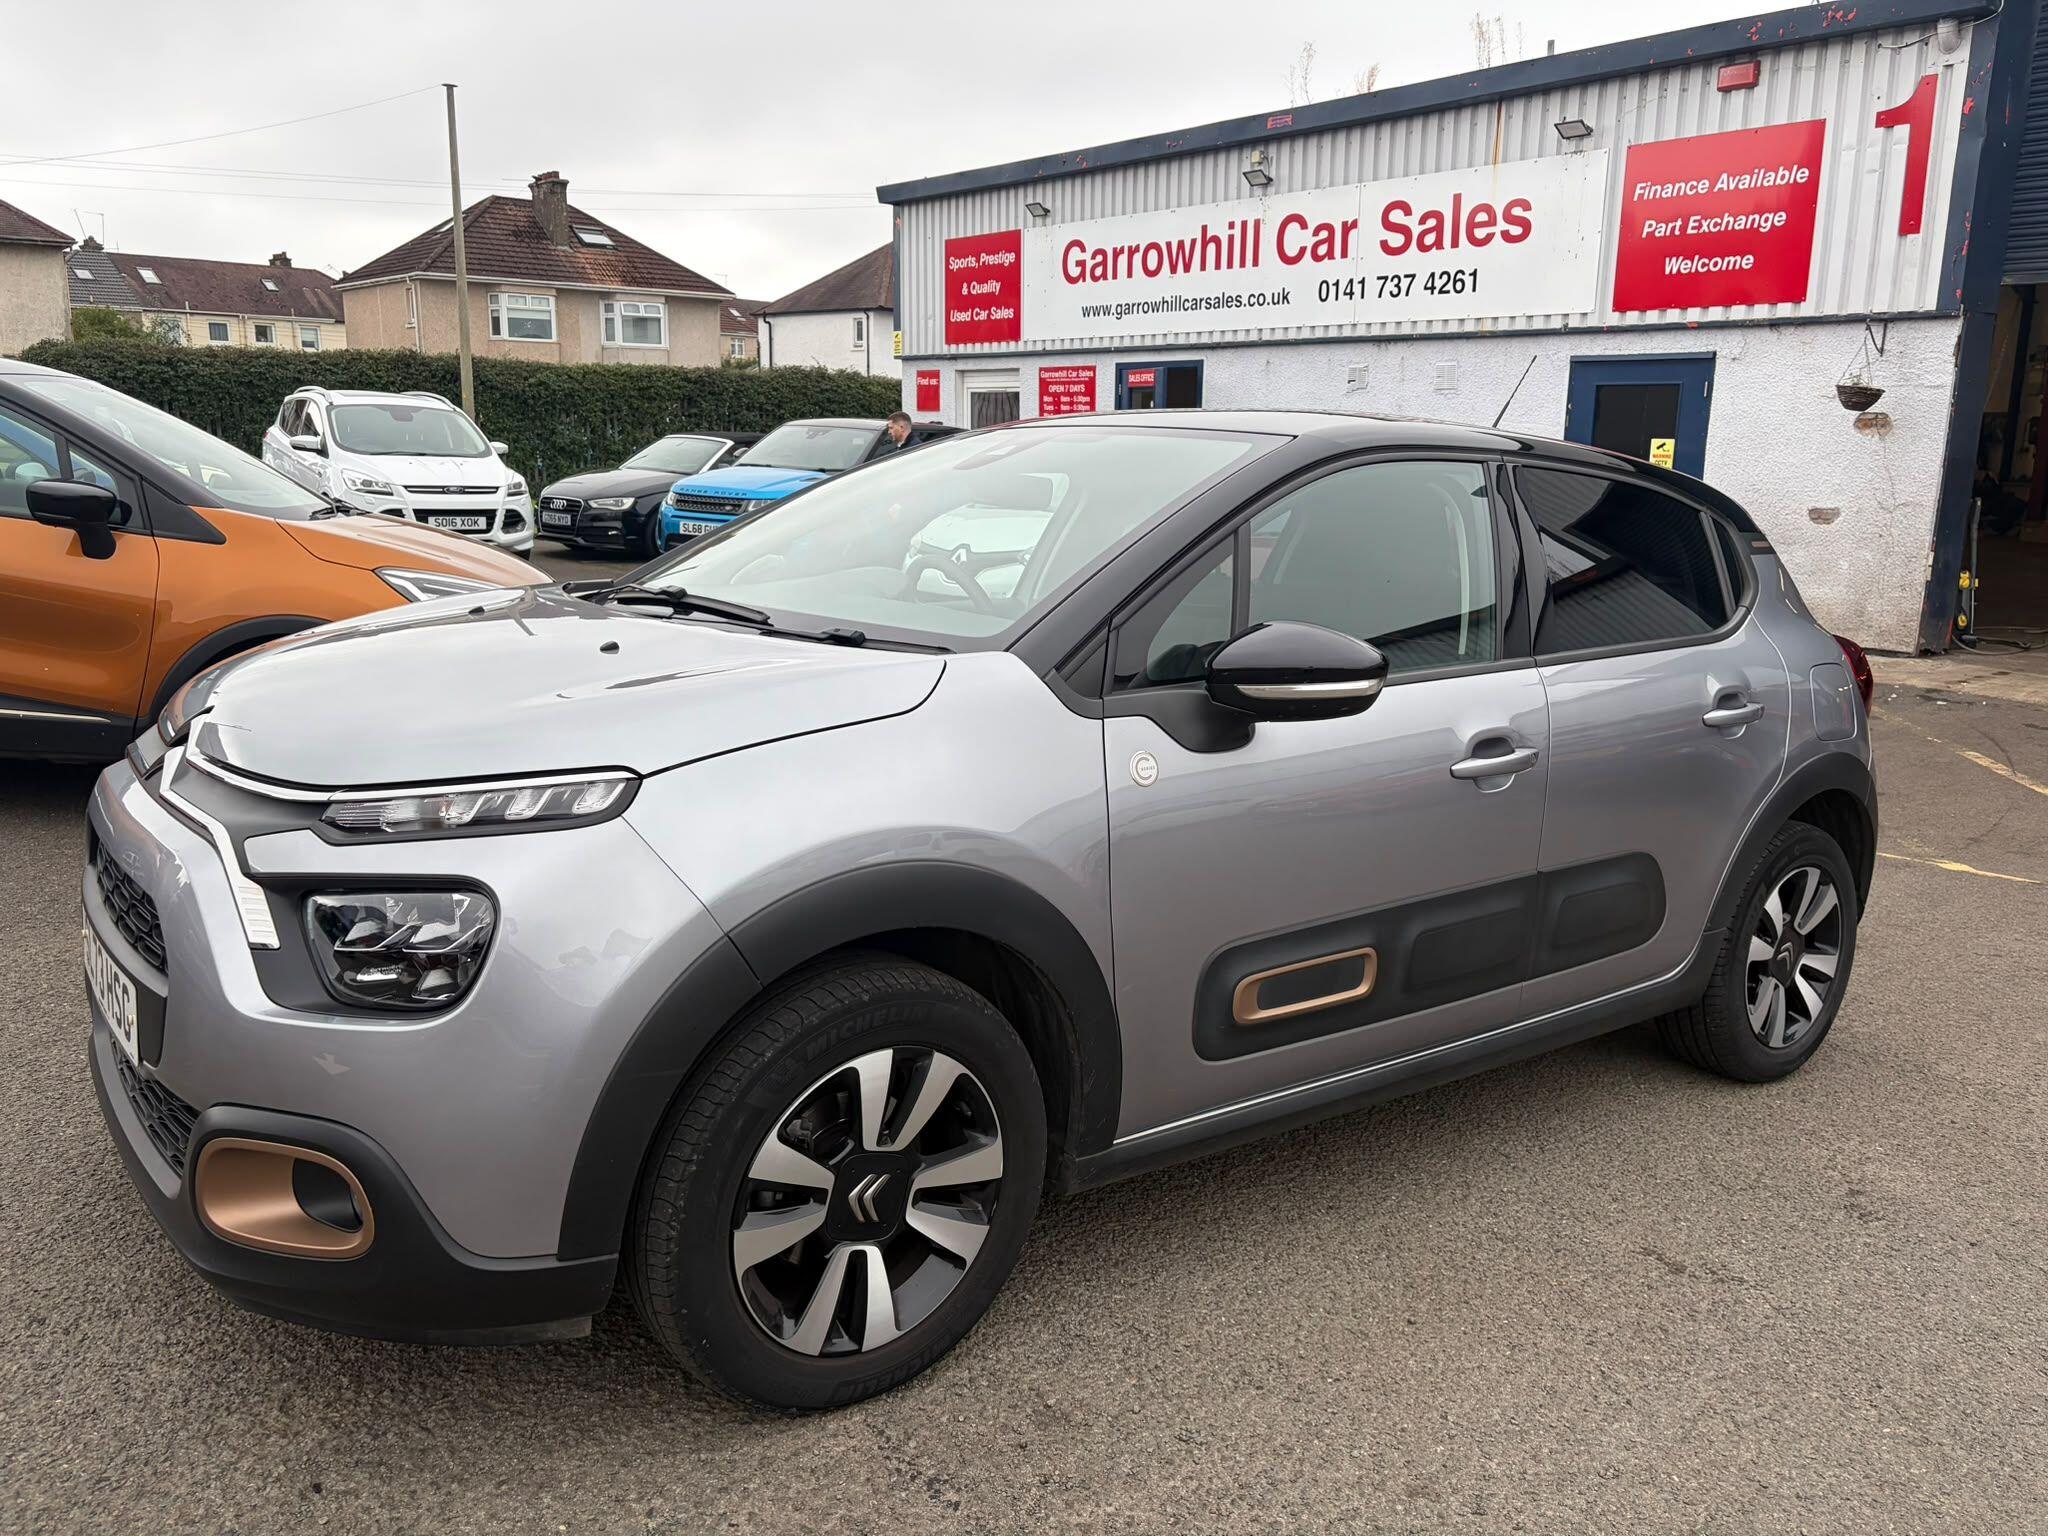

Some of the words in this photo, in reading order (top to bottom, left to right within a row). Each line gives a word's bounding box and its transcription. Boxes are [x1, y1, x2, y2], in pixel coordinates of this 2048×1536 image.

[1875, 74, 1938, 236] 1
[1633, 179, 1709, 201] Finance
[1713, 165, 1809, 192] Available
[1642, 217, 1683, 238] Part
[1686, 211, 1787, 234] Exchange
[1062, 218, 1261, 285] Garrowhill
[1276, 213, 1358, 266] Car
[1379, 192, 1532, 256] Sales
[949, 255, 979, 272] Sports,
[980, 250, 1016, 267] Prestige
[1664, 254, 1754, 275] Welcome
[962, 282, 968, 295] &
[970, 280, 1001, 296] Quality
[1318, 276, 1366, 302] 0141
[1376, 273, 1416, 298] 737
[1423, 268, 1478, 295] 4261
[950, 308, 971, 322] Used
[973, 307, 989, 321] Car
[990, 306, 1014, 320] Sales
[1081, 287, 1291, 320] www.garrowhillcarsales.co.uk
[917, 377, 929, 385] Find
[1040, 370, 1067, 378] Garrowhill
[1078, 369, 1093, 377] Sales
[1128, 374, 1140, 383] SALES
[1140, 372, 1154, 382] OFFICE
[1048, 385, 1064, 393] OPEN
[1069, 384, 1085, 392] DAYS
[434, 518, 457, 527] SO16
[460, 518, 479, 527] XOK
